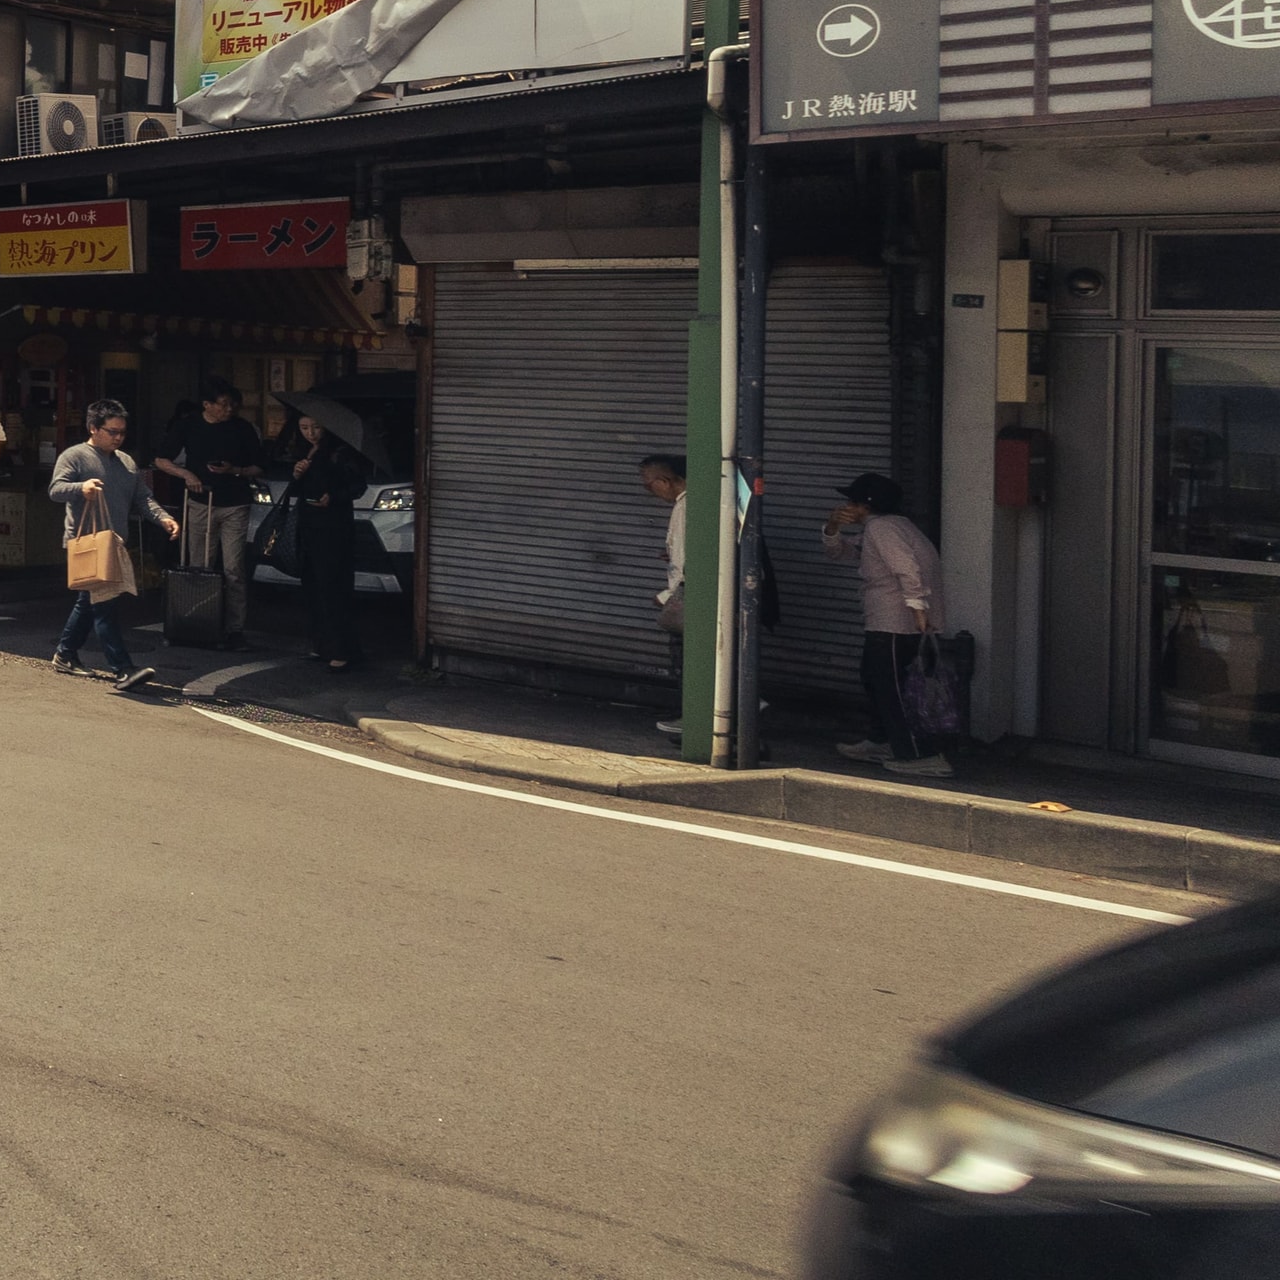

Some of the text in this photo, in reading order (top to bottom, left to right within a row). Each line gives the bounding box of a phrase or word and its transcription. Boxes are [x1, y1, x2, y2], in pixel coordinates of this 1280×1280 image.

[21, 209, 98, 227] なつかしの味
[8, 239, 118, 269] 熱海プリン
[191, 218, 337, 260] ラーメン
